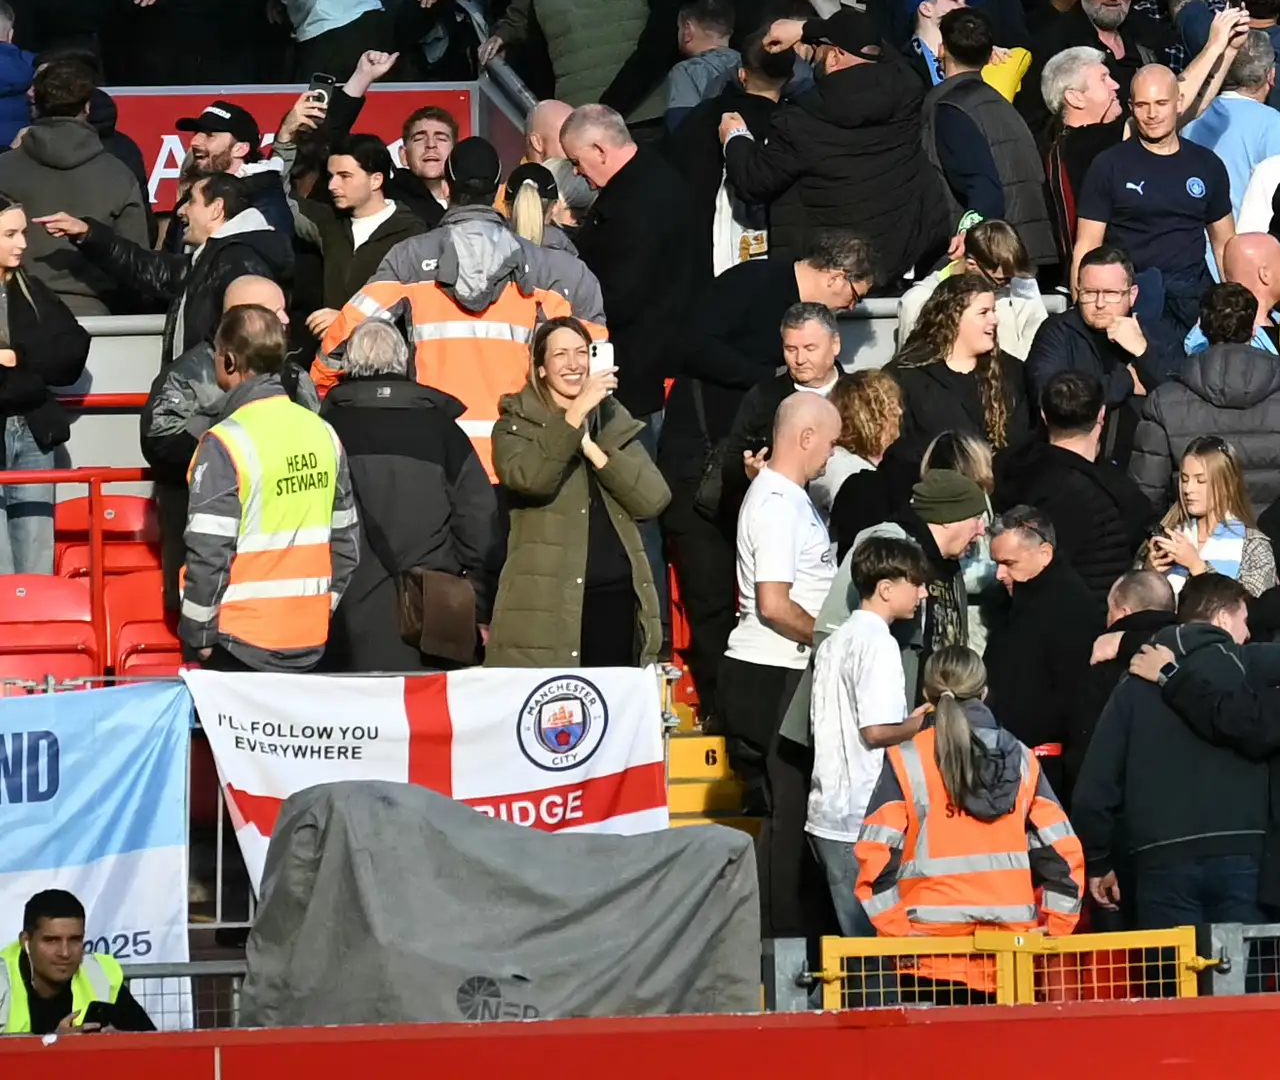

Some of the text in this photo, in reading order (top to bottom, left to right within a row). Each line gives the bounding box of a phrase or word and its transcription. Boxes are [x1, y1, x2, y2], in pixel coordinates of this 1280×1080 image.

[286, 452, 318, 474] HEAD
[276, 471, 329, 497] STEWARD
[527, 682, 597, 716] MANCHESTER
[250, 721, 334, 740] FOLLOW
[339, 726, 379, 741] YOU
[235, 736, 363, 760] EVERYWHERE
[704, 749, 718, 767] 6
[551, 752, 579, 767] CITY
